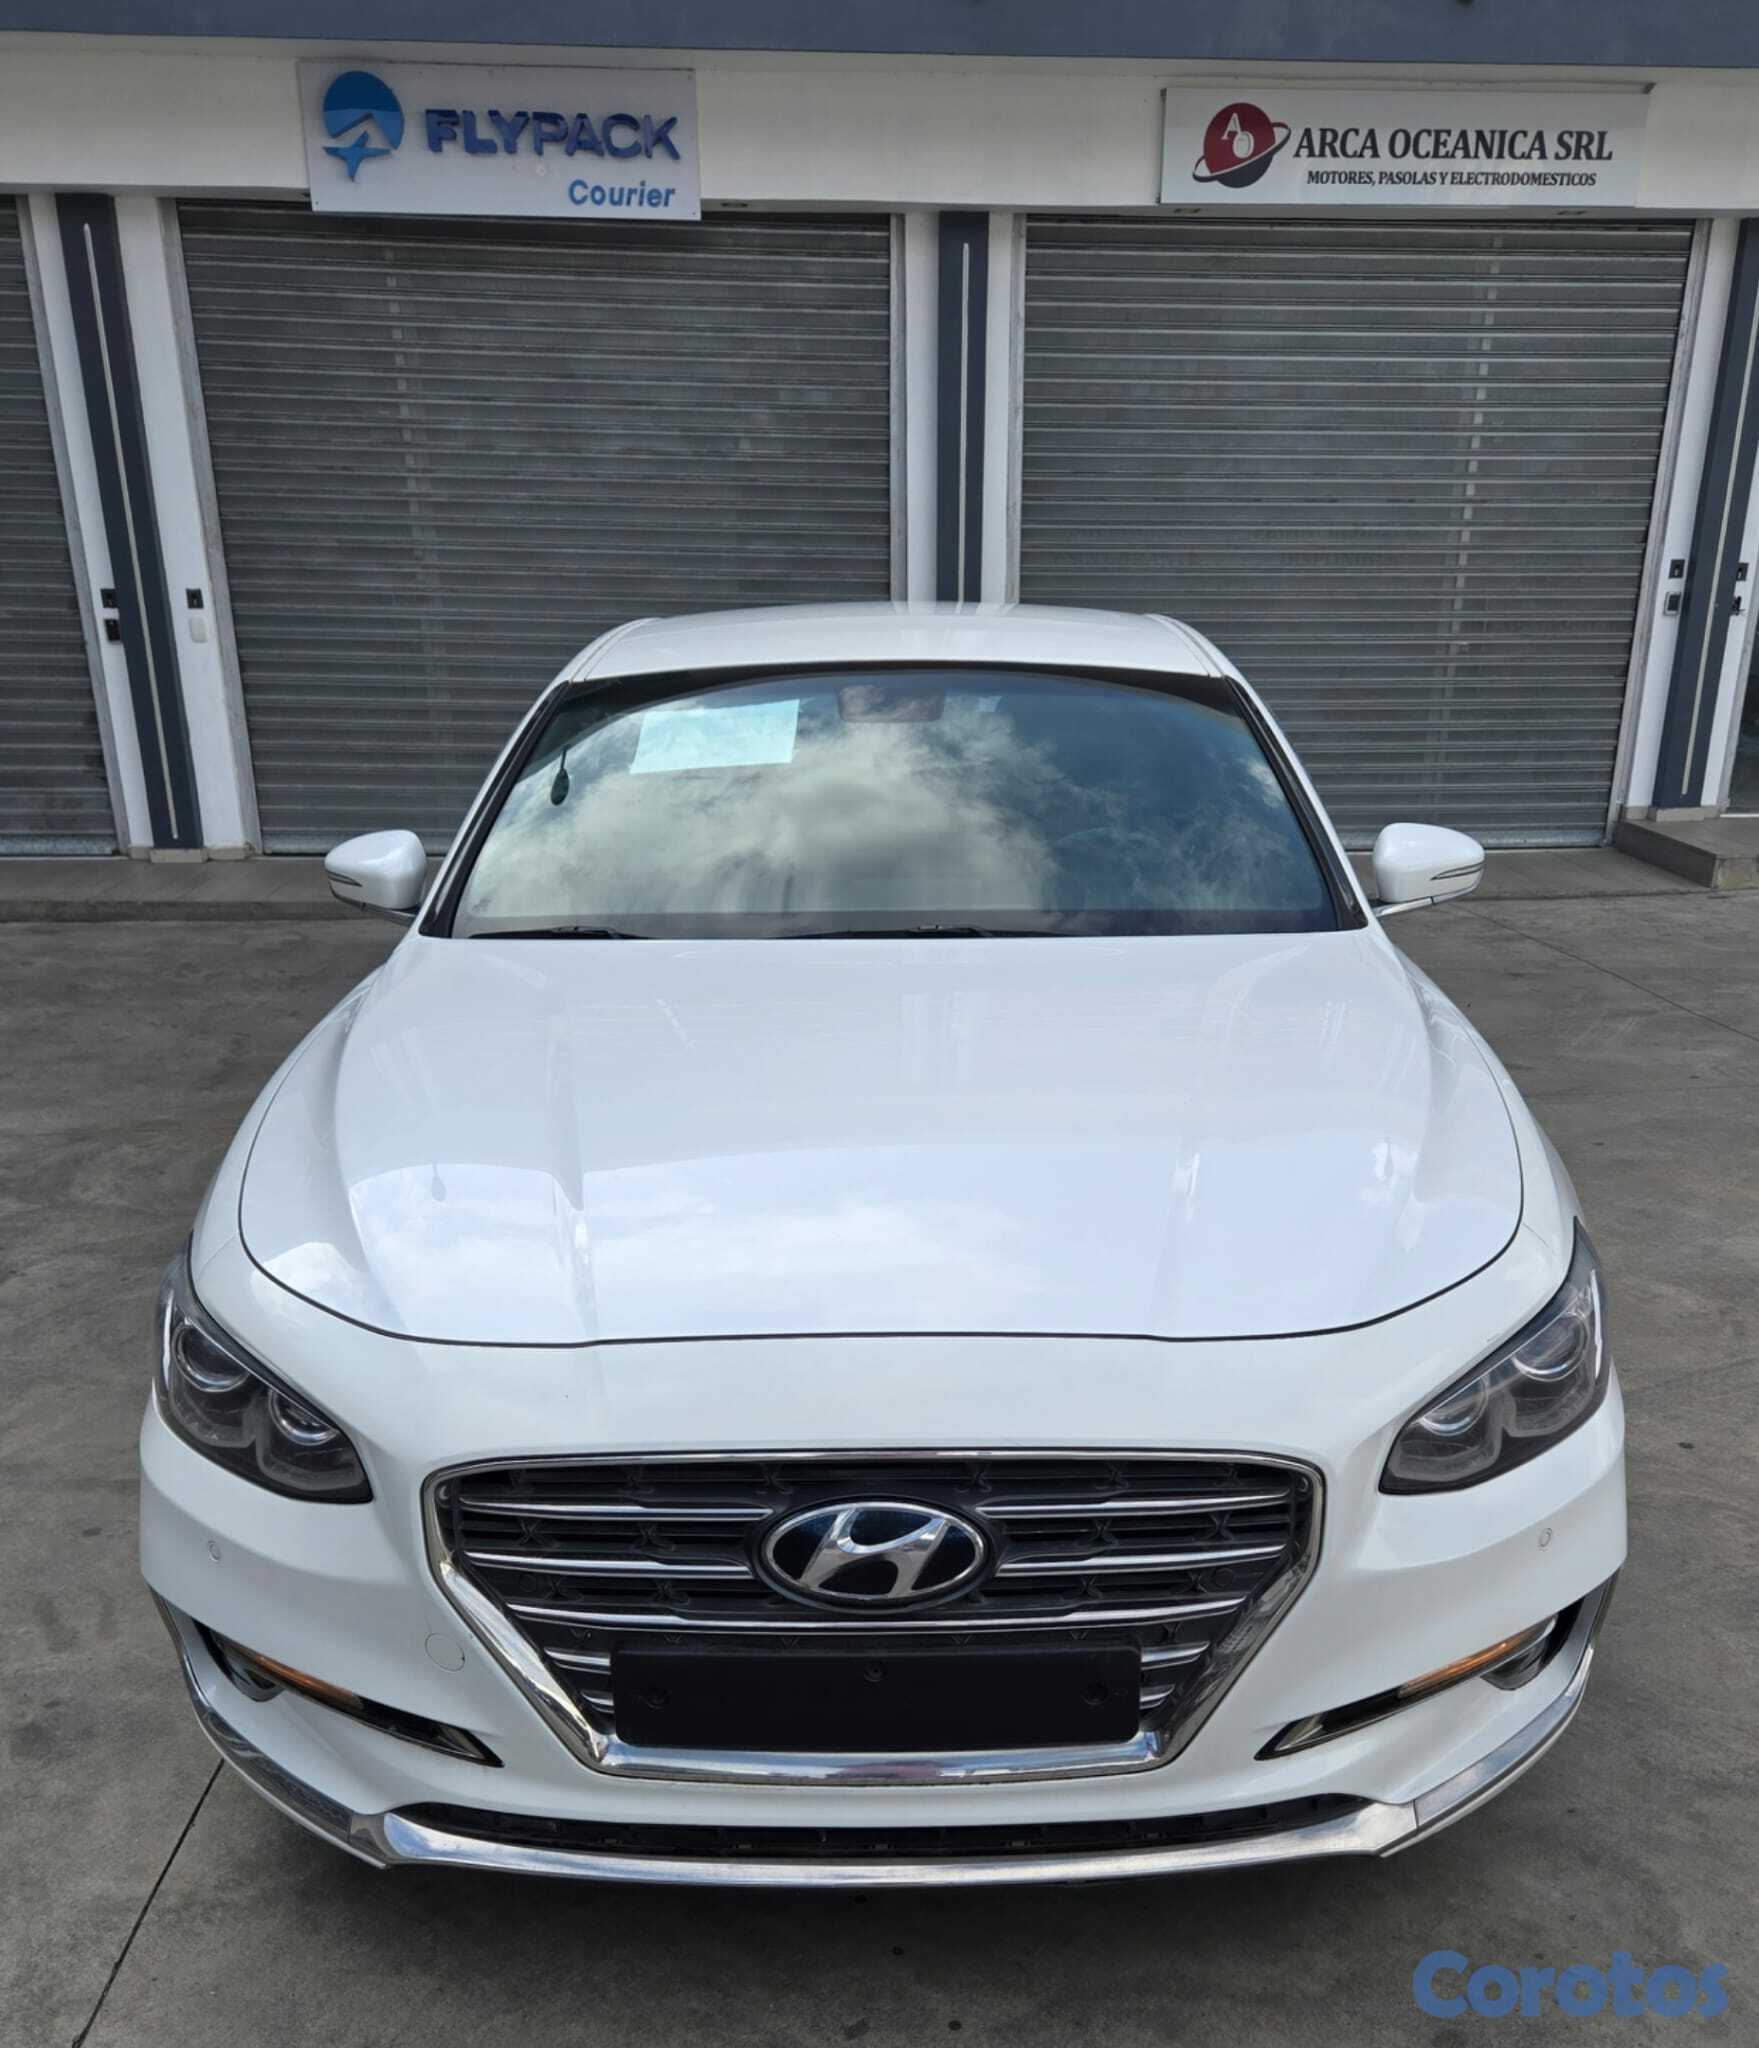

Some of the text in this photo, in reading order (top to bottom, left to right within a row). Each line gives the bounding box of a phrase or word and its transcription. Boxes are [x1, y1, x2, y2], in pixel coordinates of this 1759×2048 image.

[425, 109, 681, 160] FLYPACK
[1292, 127, 1614, 161] ARCA OCEANICA SRL
[567, 178, 676, 209] Courier
[1307, 170, 1598, 187] MOTORES, PASOLAS Y ELECTRODOMESTICOS
